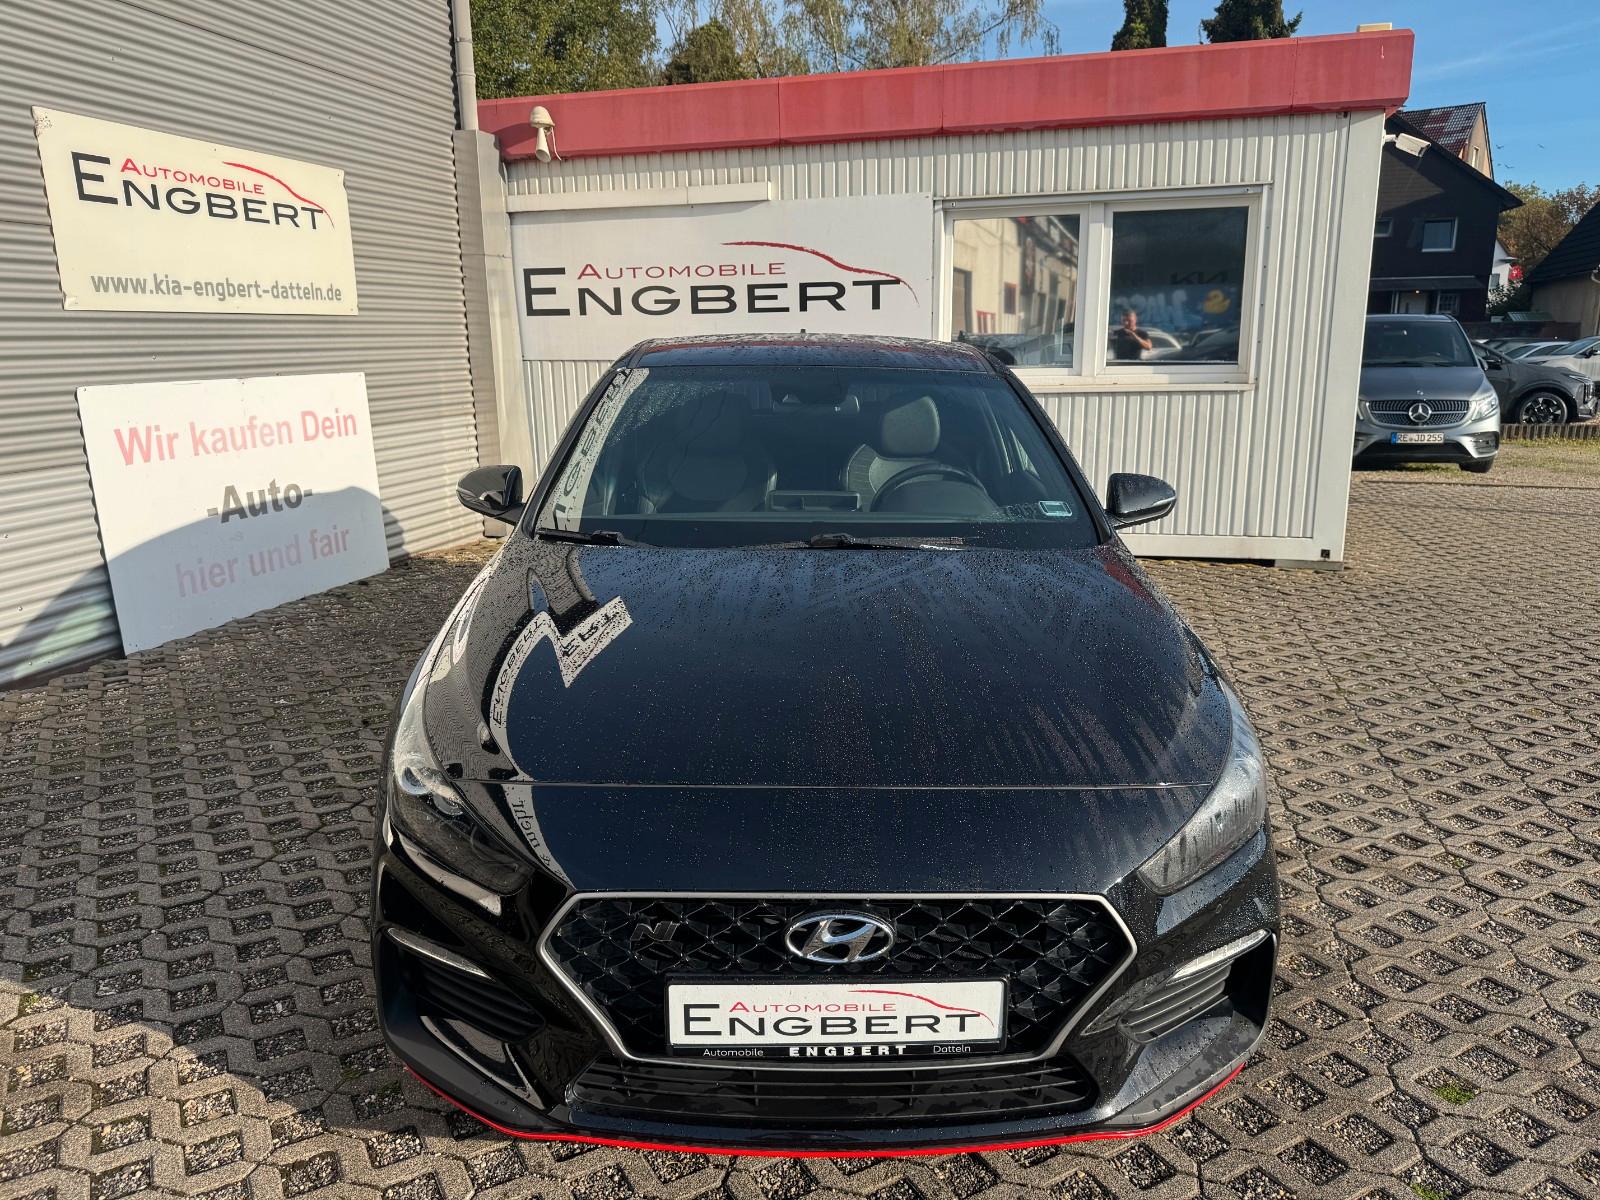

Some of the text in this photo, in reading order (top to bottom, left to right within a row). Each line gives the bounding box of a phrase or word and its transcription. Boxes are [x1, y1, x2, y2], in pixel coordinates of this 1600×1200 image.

[71, 151, 324, 230] ENGBERT
[120, 157, 265, 194] AUTOMOBILE
[90, 274, 342, 301] www.kia-engbert-datteln.de
[577, 262, 786, 280] AUTOMOBILE
[523, 267, 900, 317] ENGBERT
[113, 408, 357, 466] Wir kaufen Dein
[176, 524, 349, 598] hier und fair
[683, 1003, 980, 1036] ENGBERT
[729, 1001, 897, 1013] AUTOMOBILE
[703, 1044, 971, 1058] Automobile ENGBERT Datteln
